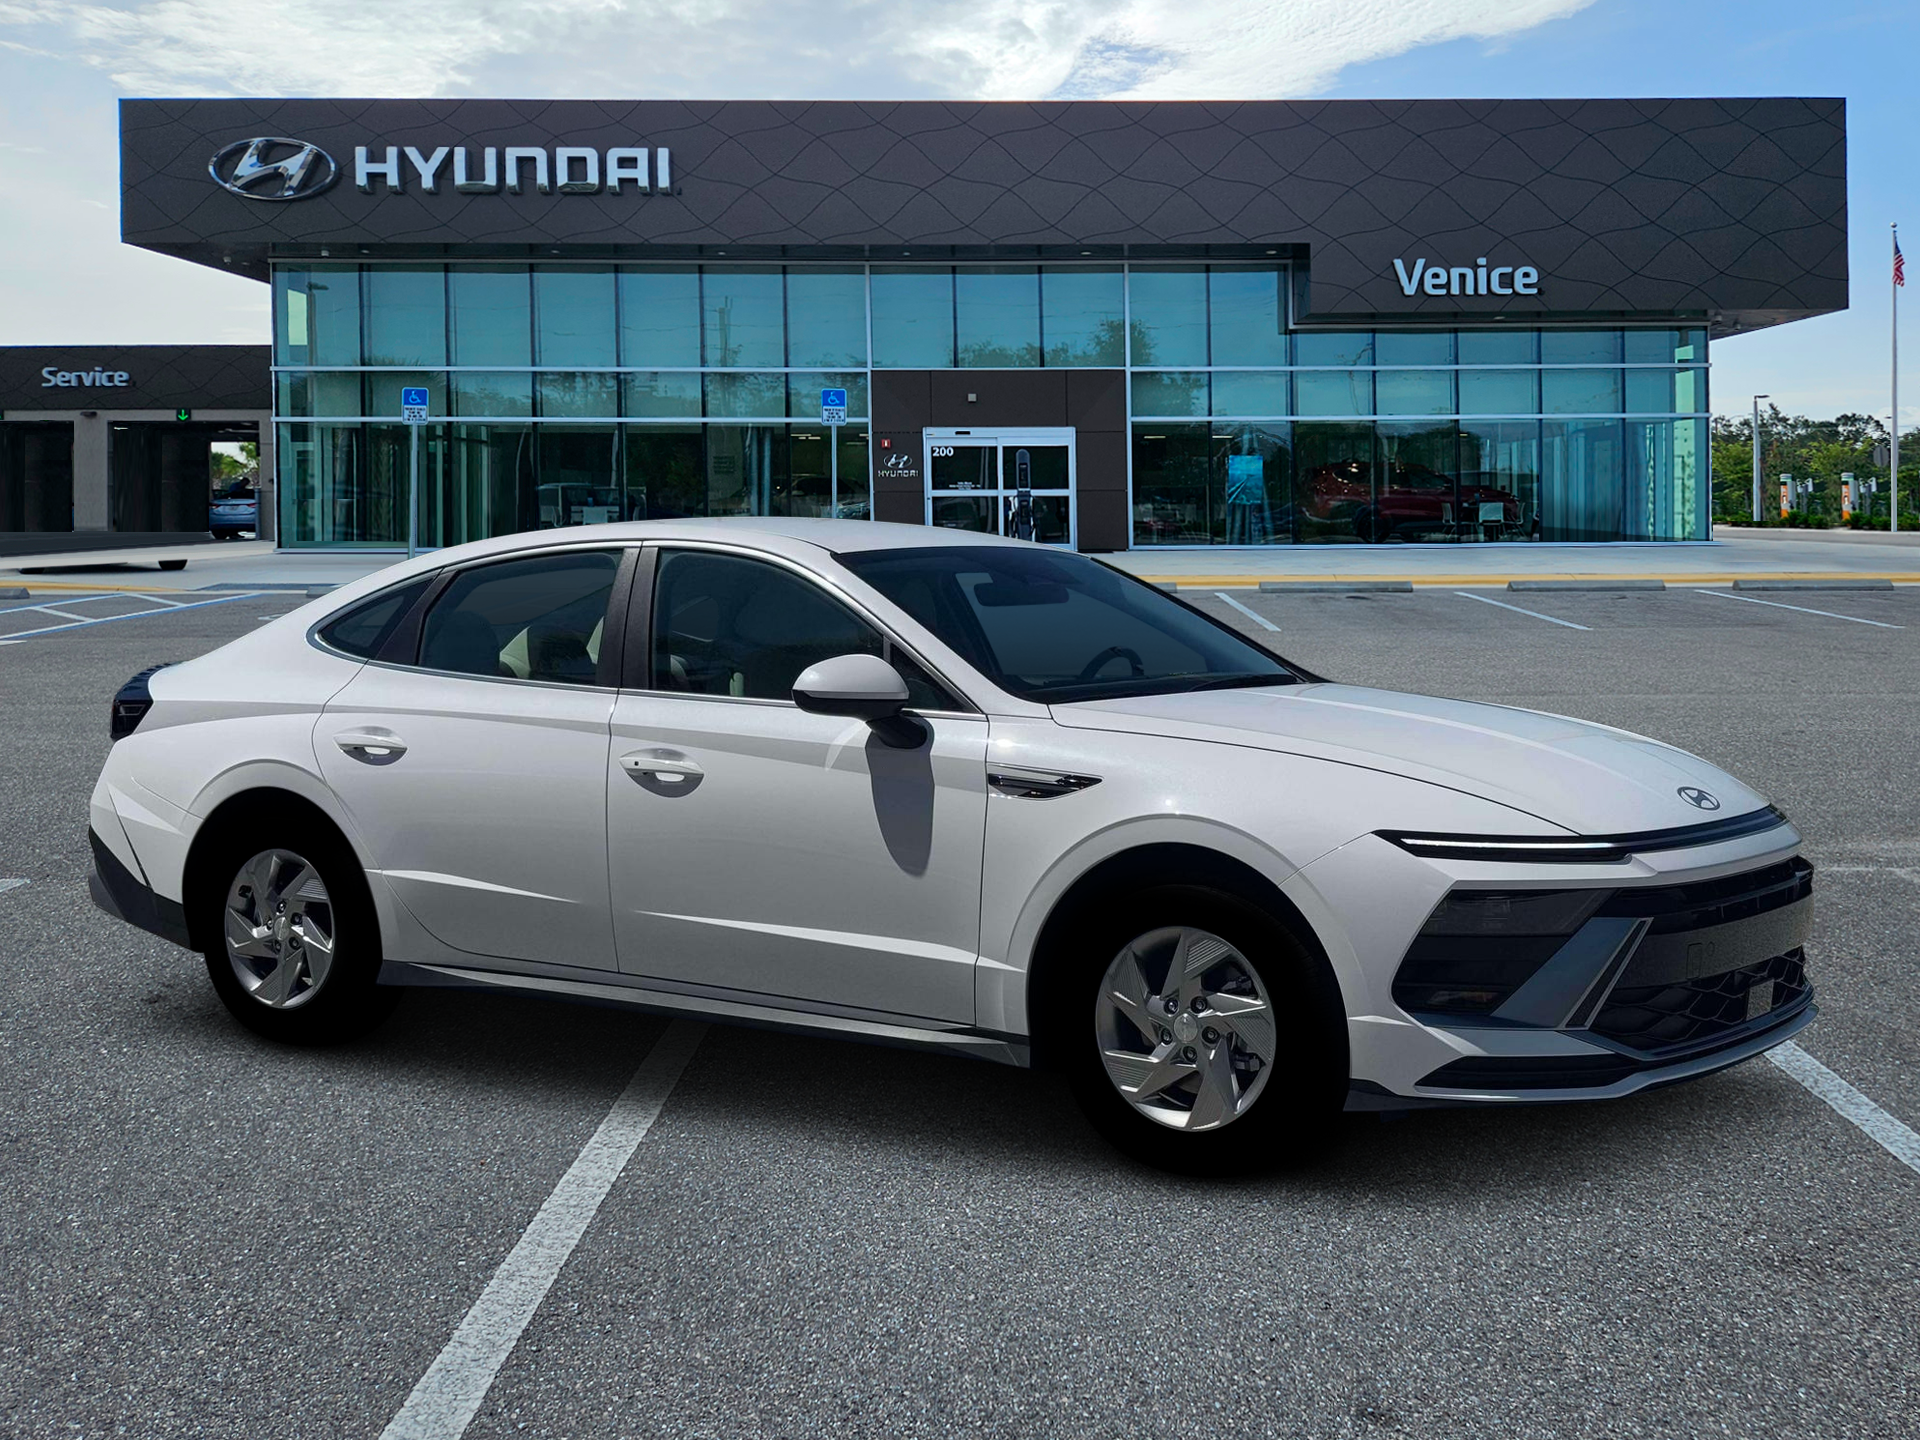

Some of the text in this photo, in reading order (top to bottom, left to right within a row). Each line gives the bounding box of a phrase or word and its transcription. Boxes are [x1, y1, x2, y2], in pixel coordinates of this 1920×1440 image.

[354, 146, 671, 192] HYUNDAI
[1392, 257, 1539, 296] Venice
[41, 367, 130, 387] Service
[932, 446, 954, 457] 200
[877, 470, 919, 478] HYUNDAI
